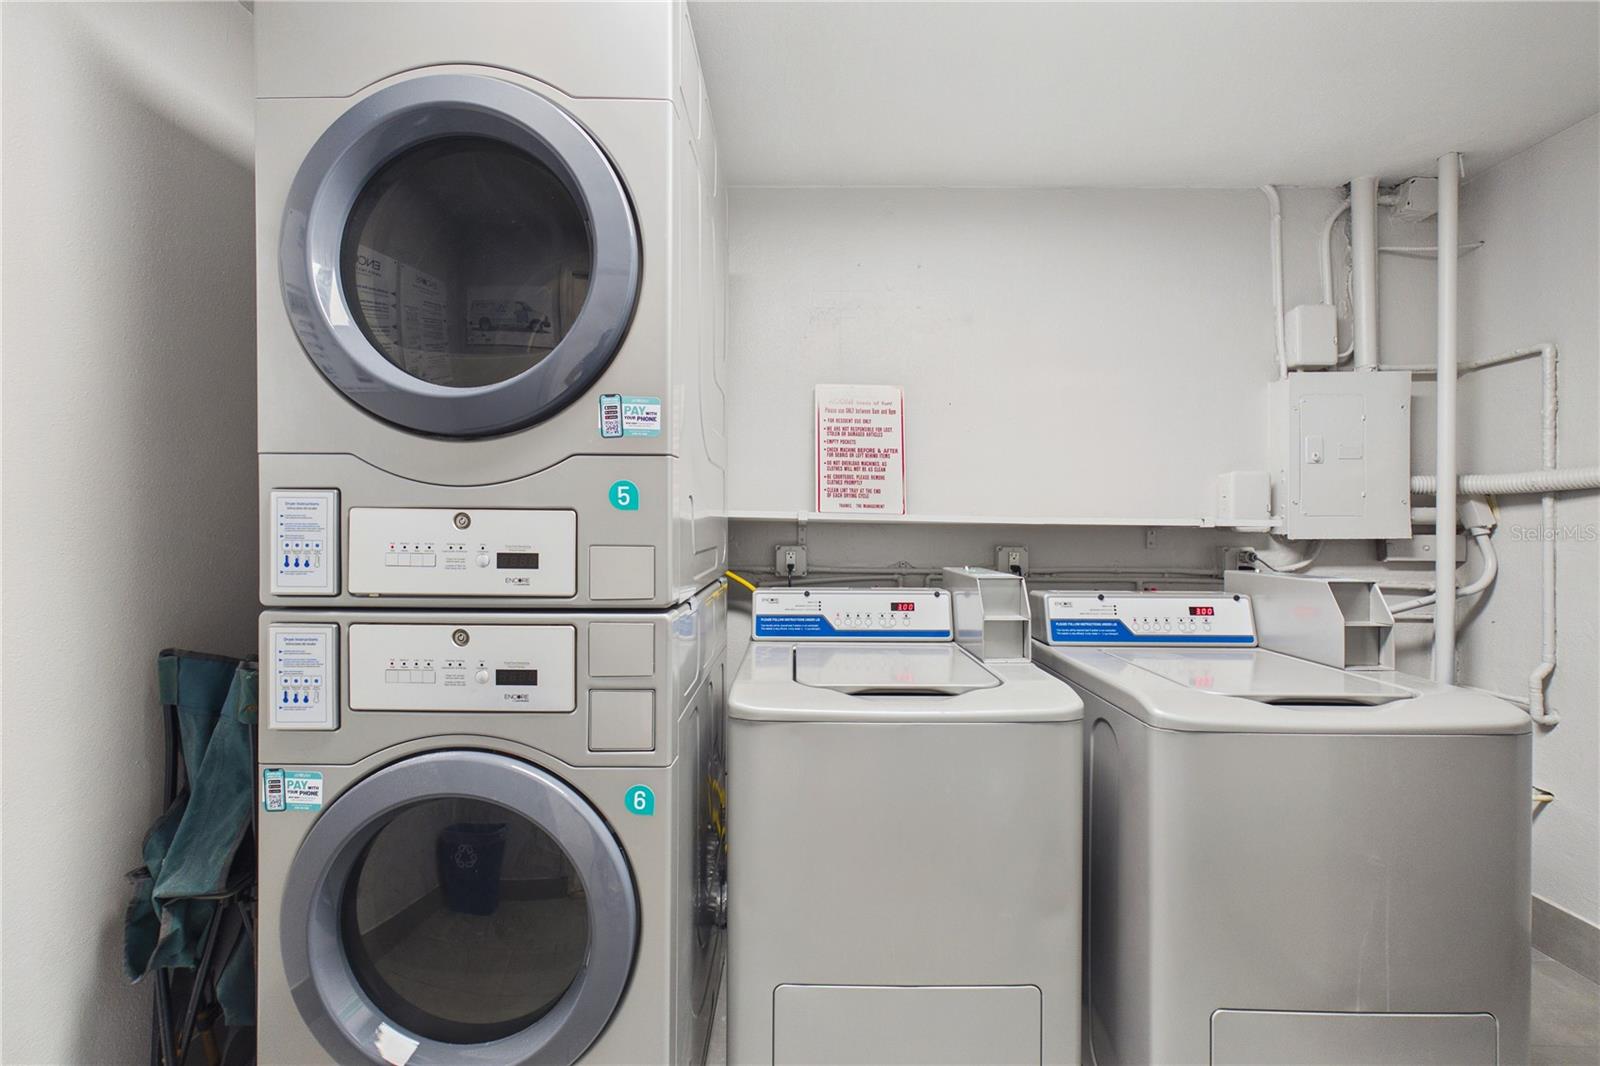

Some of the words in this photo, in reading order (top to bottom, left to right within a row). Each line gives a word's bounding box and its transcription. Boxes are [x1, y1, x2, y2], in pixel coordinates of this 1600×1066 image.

[624, 406, 646, 415] PAY
[618, 486, 630, 506] 5
[287, 780, 308, 789] PAY
[634, 791, 646, 810] 6
